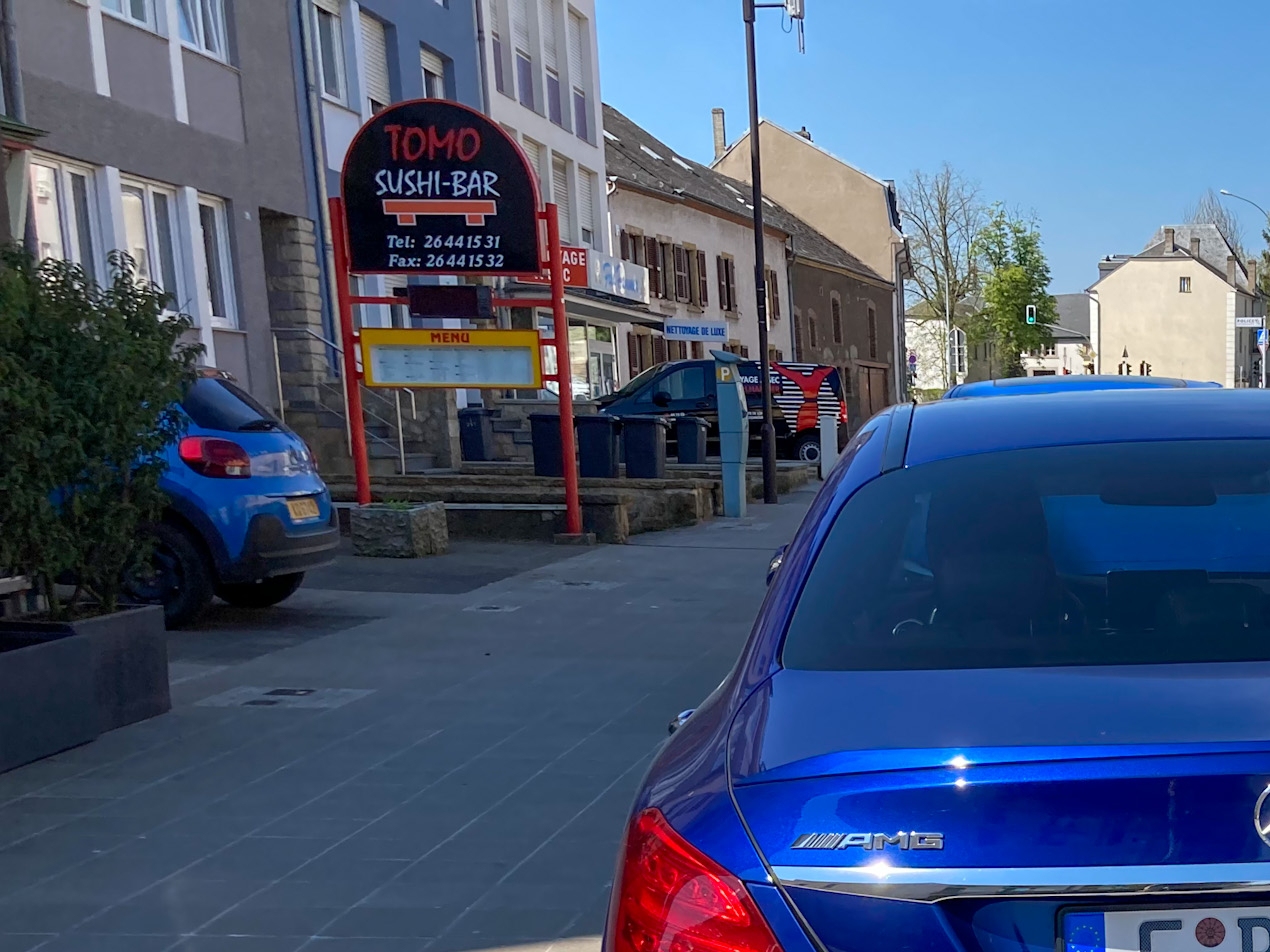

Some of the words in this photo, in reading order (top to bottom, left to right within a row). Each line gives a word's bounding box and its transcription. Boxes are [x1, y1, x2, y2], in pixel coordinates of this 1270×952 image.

[384, 124, 481, 162] TOMO
[374, 168, 501, 197] SUSHI-BAR
[387, 235, 416, 249] Tel:
[388, 254, 422, 268] Fax:
[430, 332, 470, 344] MENU
[666, 325, 700, 335] NETTOYAGE
[701, 327, 709, 336] DE
[710, 327, 725, 337] LUXE
[721, 367, 730, 381] P
[836, 832, 945, 850] AMG
